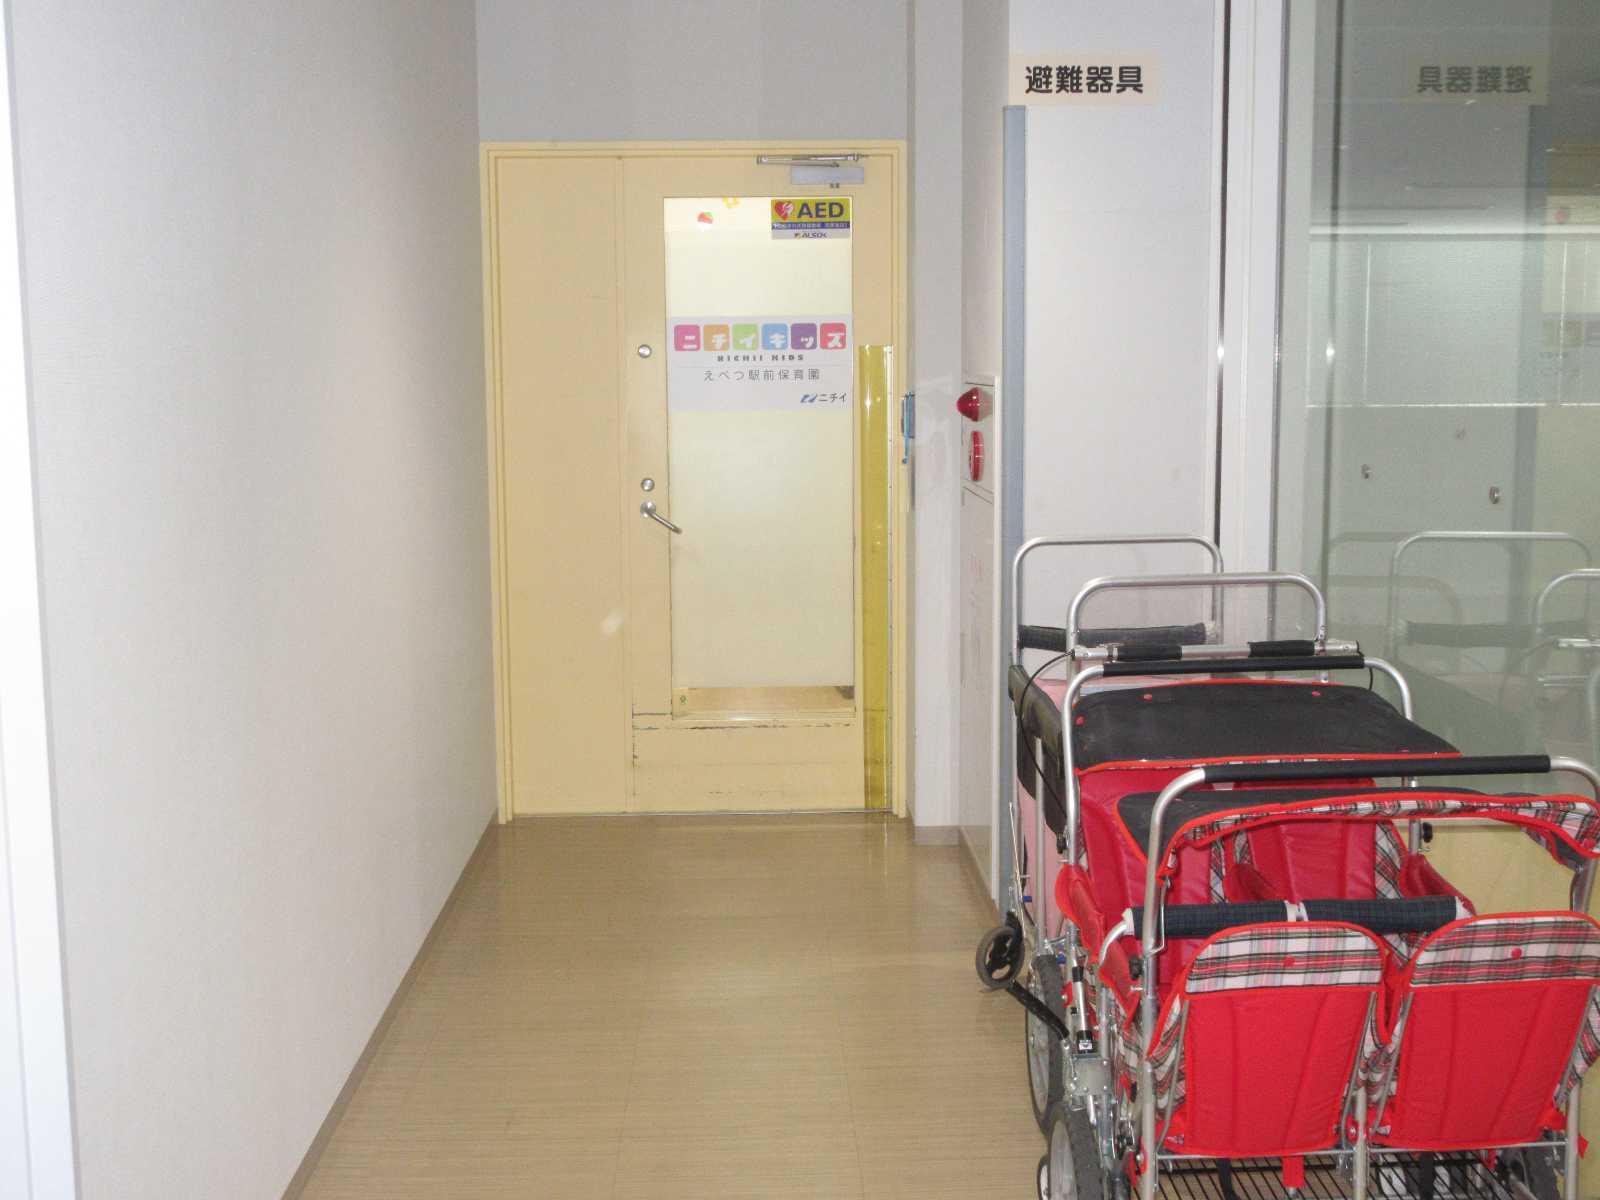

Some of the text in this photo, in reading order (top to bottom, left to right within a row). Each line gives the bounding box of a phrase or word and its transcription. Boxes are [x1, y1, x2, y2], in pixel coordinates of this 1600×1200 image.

[1025, 65, 1143, 93] 避難器具
[797, 202, 844, 218] AED
[676, 327, 846, 351] ニチイキッズ
[818, 392, 847, 403] ニチイ
